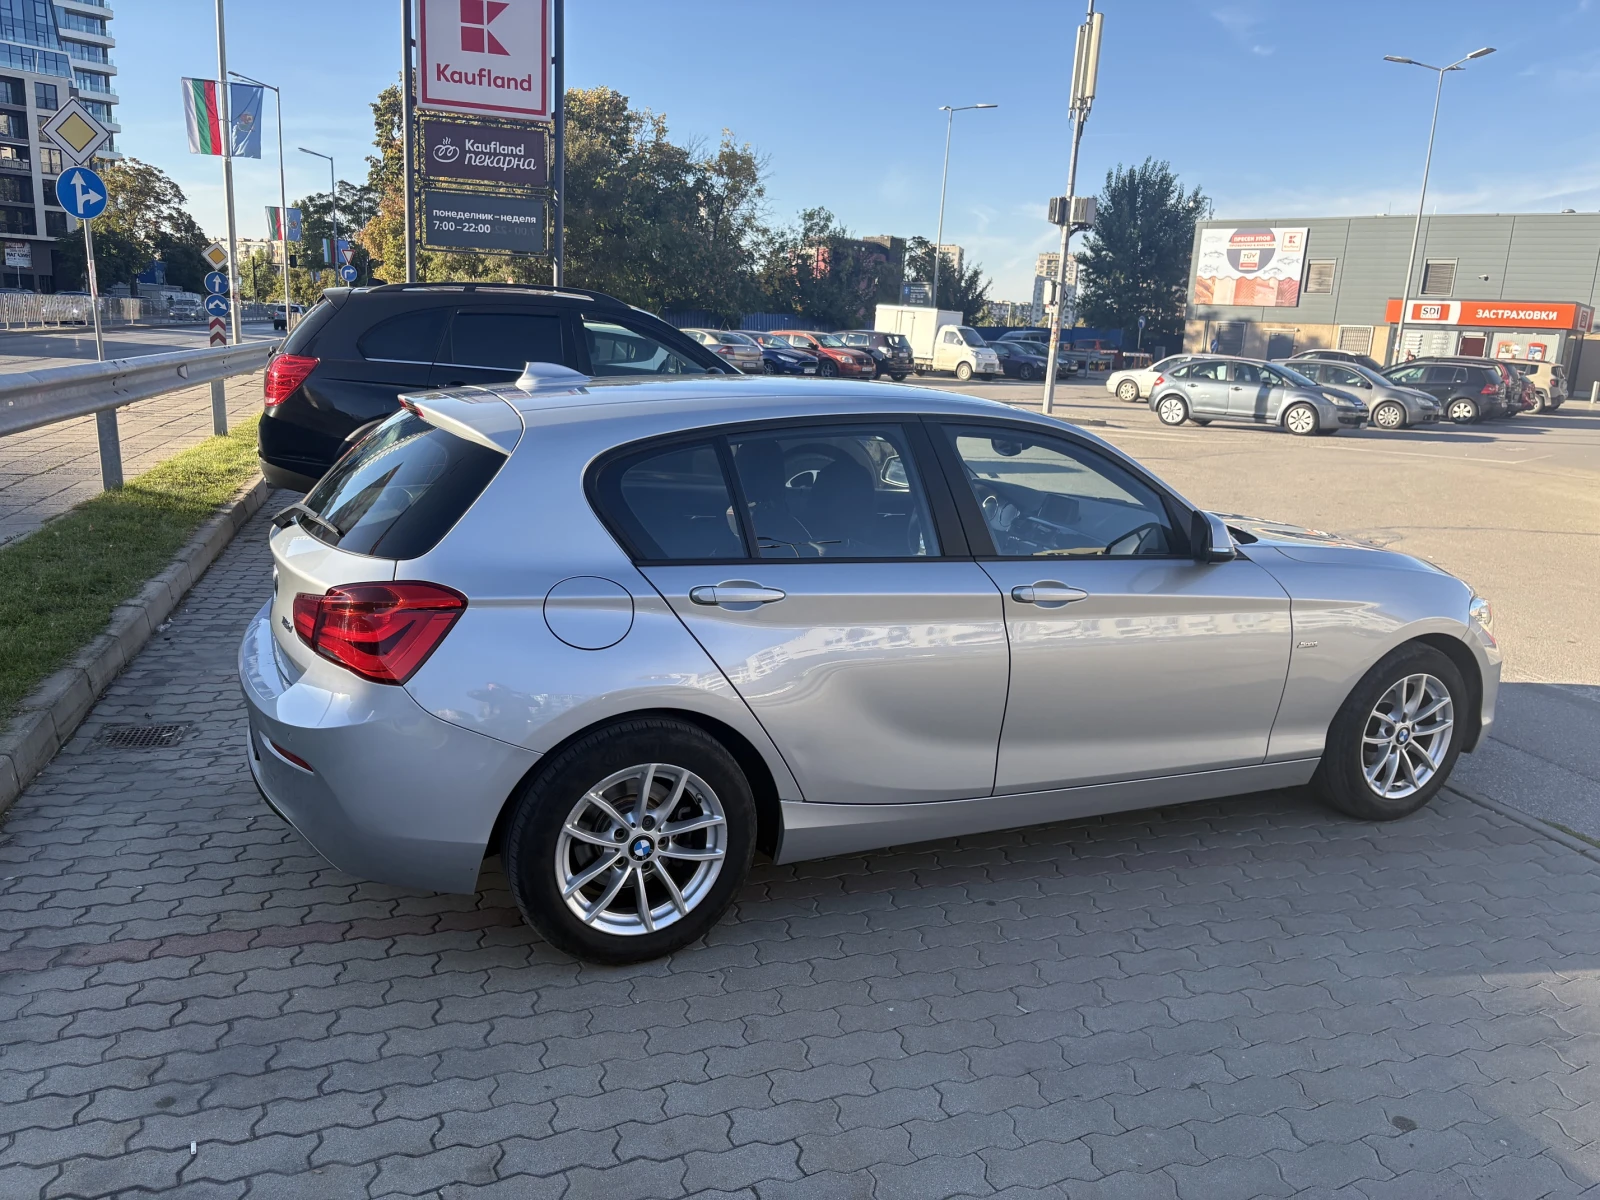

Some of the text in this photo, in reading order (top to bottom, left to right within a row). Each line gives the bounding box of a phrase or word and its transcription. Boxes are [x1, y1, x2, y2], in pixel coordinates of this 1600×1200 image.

[436, 63, 532, 92] Kaufland
[465, 139, 525, 155] Kaufland
[464, 153, 537, 171] пекарна
[1422, 306, 1440, 315] SDI
[1475, 308, 1558, 321] ЗАСТРАХОВКИ
